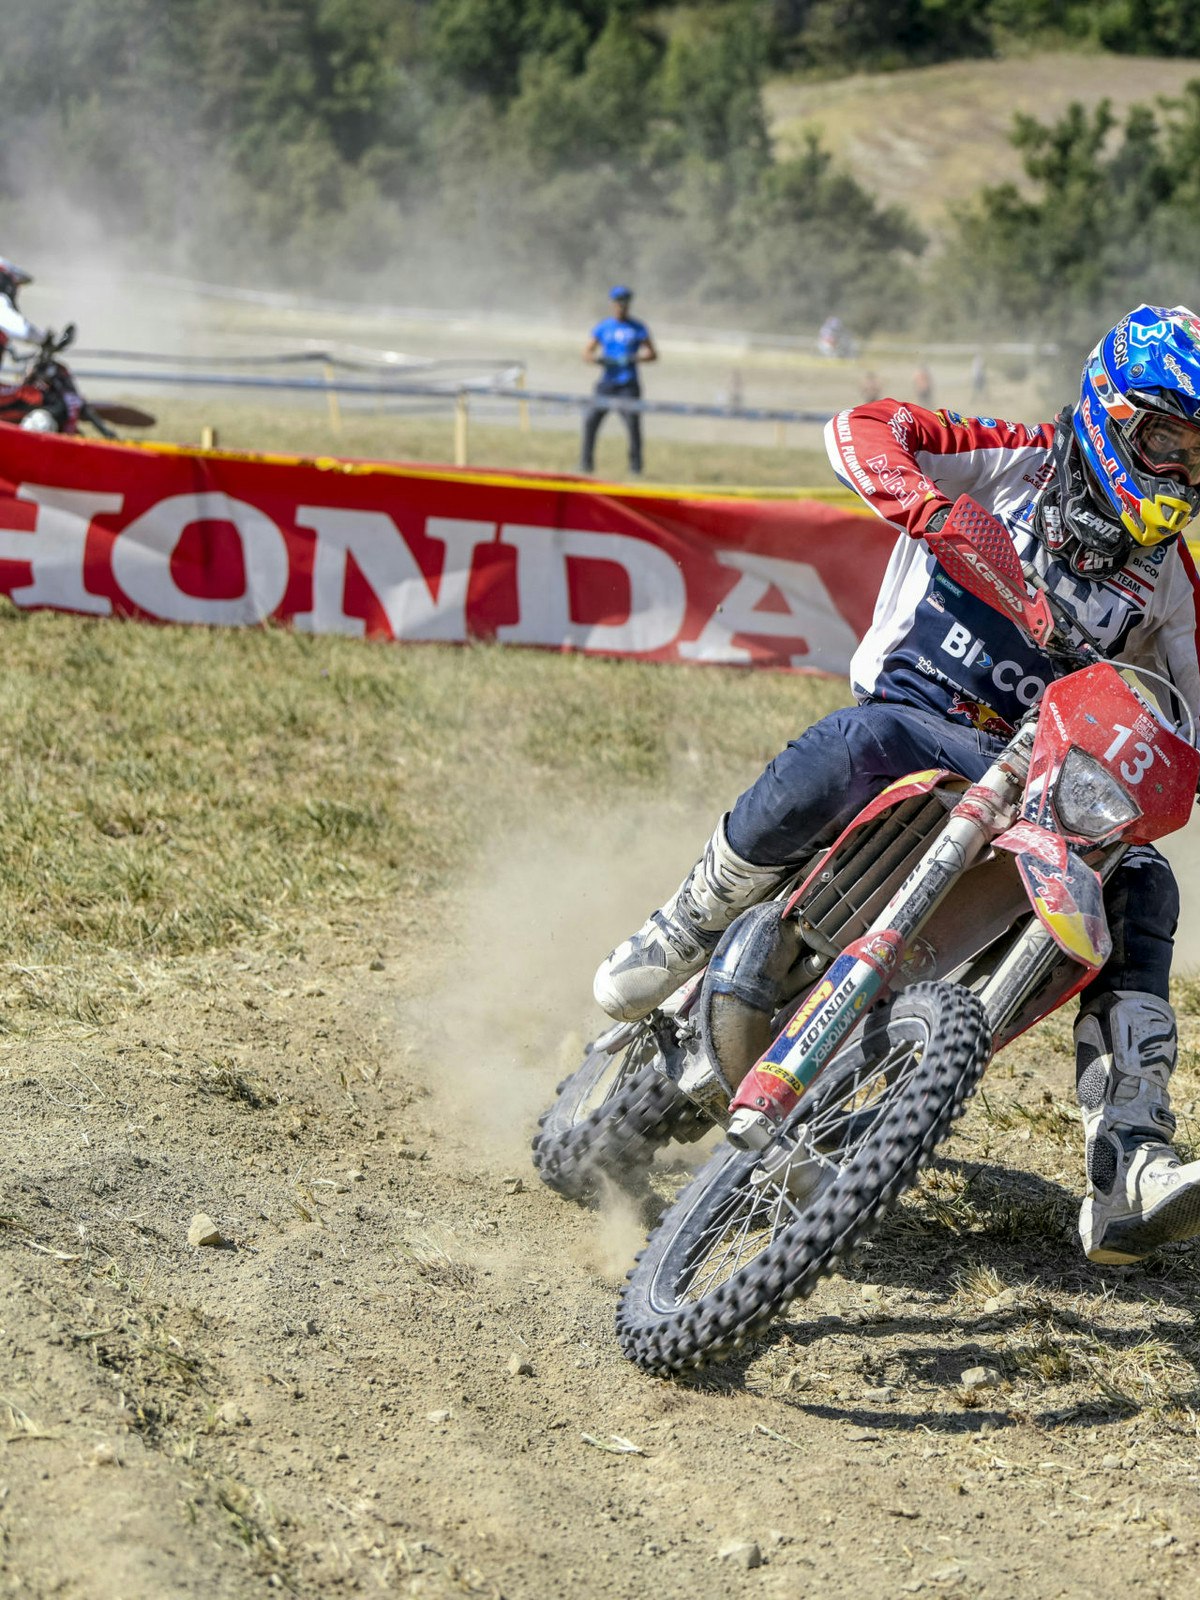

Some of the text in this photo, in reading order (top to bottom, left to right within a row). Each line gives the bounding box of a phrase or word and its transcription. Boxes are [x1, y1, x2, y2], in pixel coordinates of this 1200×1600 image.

[841, 445, 877, 496] PLUMBING
[1069, 507, 1122, 539] LEATT
[0, 483, 861, 676] HONDA
[962, 552, 1024, 612] ACERBIS
[1117, 574, 1142, 593] TEAM
[1049, 702, 1069, 741] GASGAS
[1103, 723, 1155, 784] 13
[1152, 744, 1171, 768] MOTUL
[800, 977, 857, 1057] DUNLOP
[811, 1007, 857, 1068] MOTOREX
